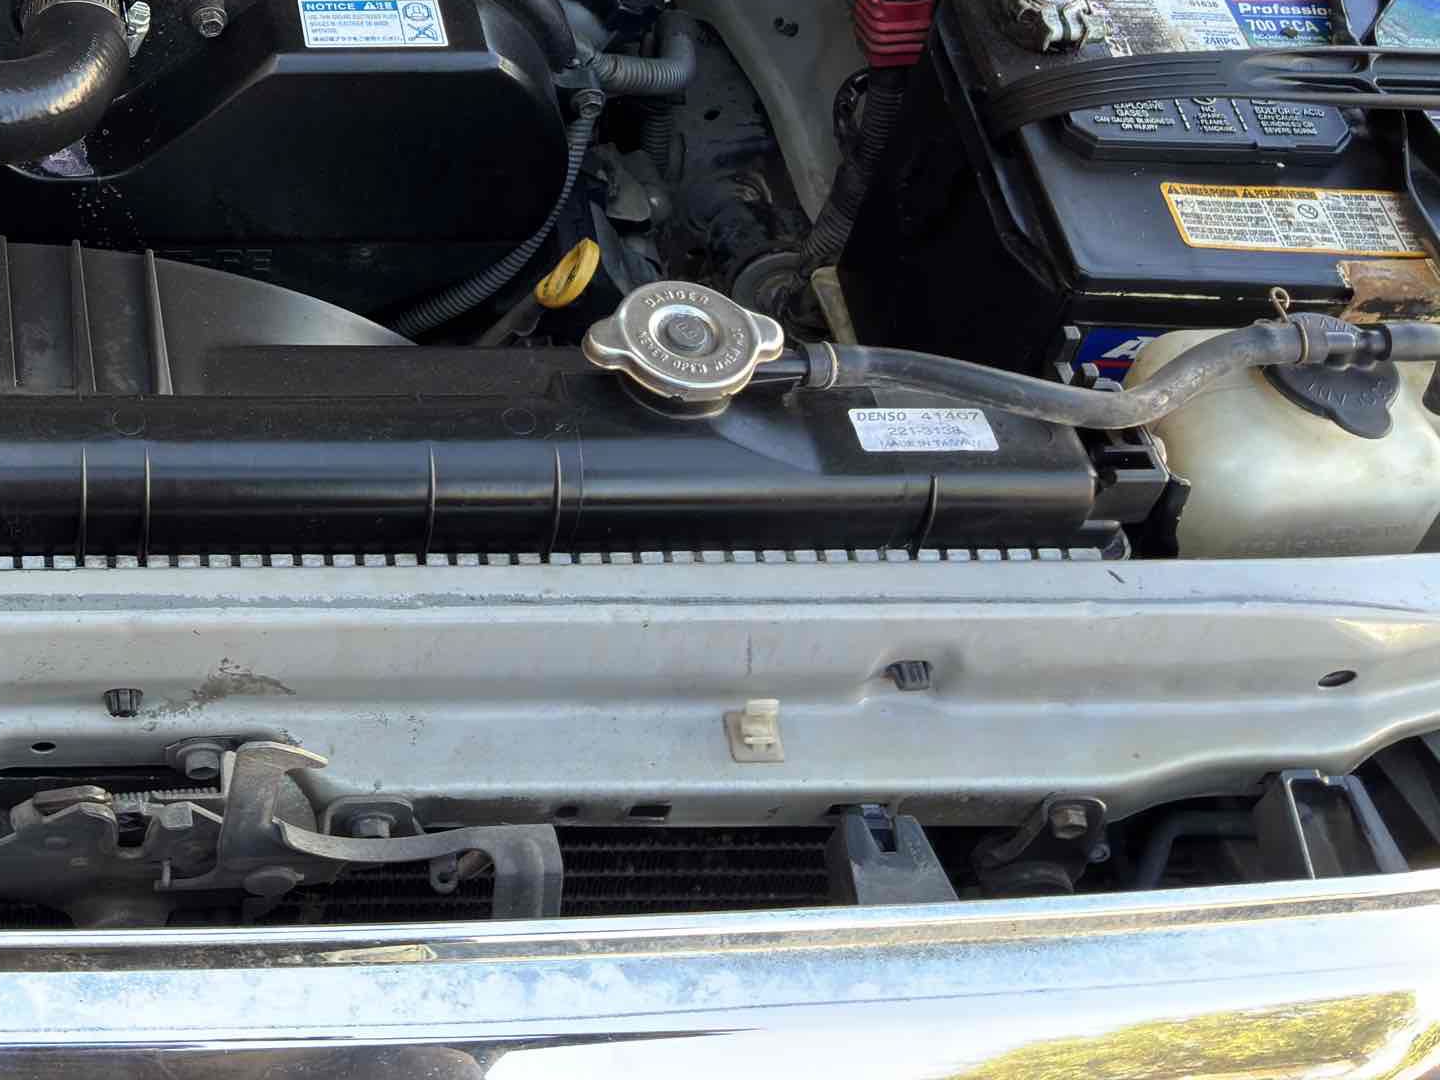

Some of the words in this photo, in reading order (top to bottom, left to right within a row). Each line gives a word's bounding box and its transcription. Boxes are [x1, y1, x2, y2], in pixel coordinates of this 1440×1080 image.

[306, 2, 357, 10] NOTICE
[1246, 19, 1277, 32] 700
[856, 411, 907, 422] DENSO
